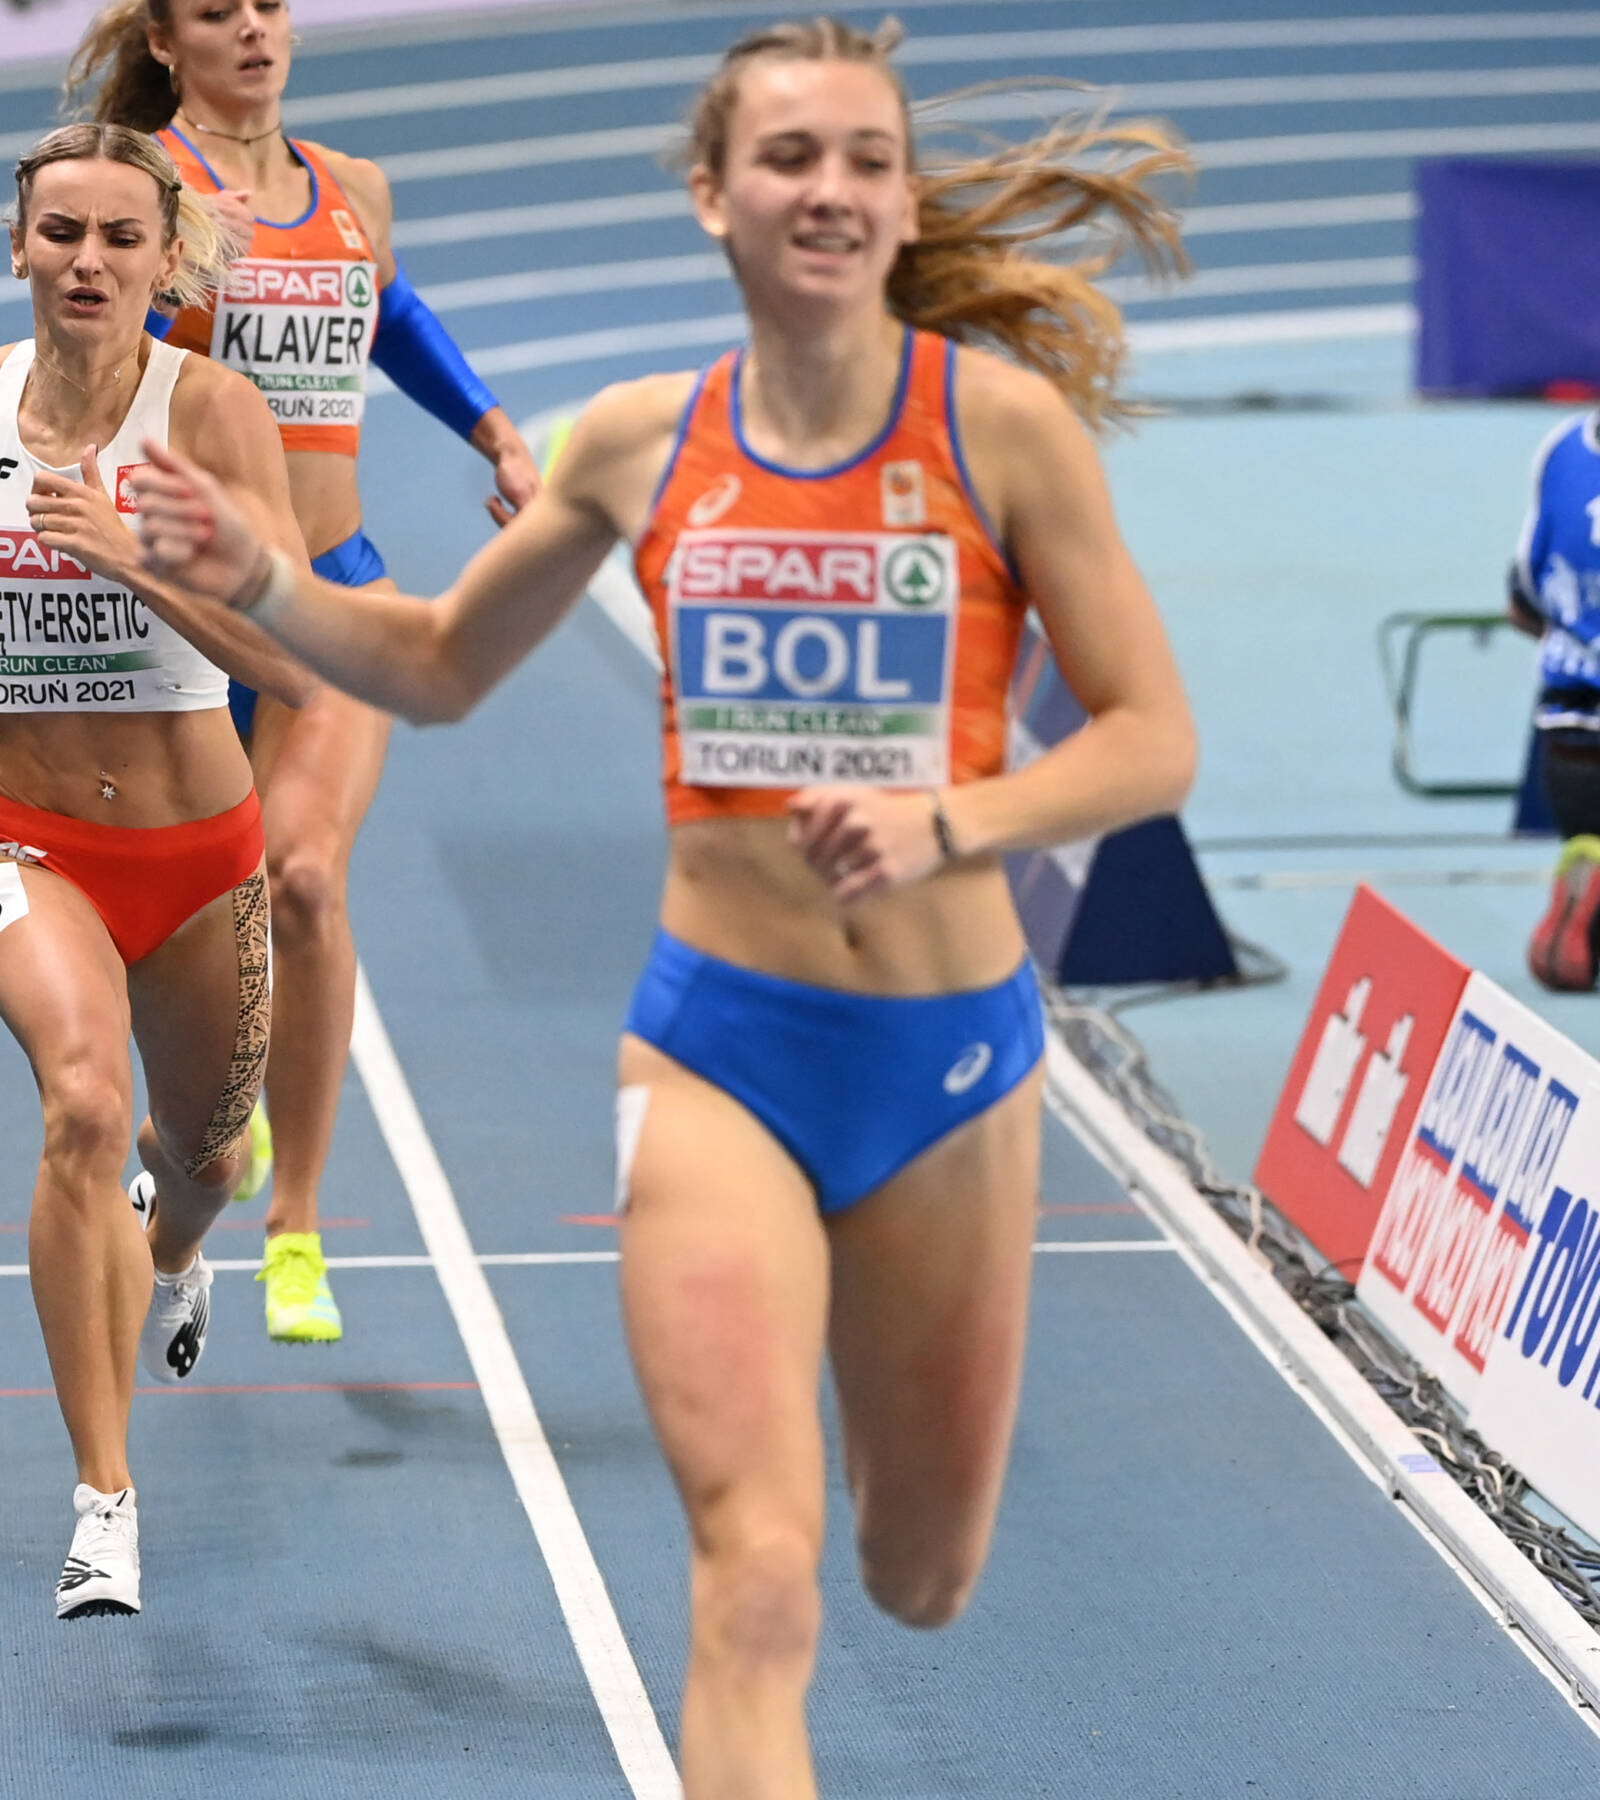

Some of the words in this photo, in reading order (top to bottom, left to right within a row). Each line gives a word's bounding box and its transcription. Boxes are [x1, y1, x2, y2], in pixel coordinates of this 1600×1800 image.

[229, 268, 340, 300] SPAR
[221, 312, 365, 365] KLAVER
[267, 396, 314, 417] RUŃ
[319, 399, 354, 417] 2021
[684, 545, 875, 598] SPAR
[703, 613, 912, 698] BOL
[75, 680, 135, 703] 2021
[832, 745, 915, 778] 2021
